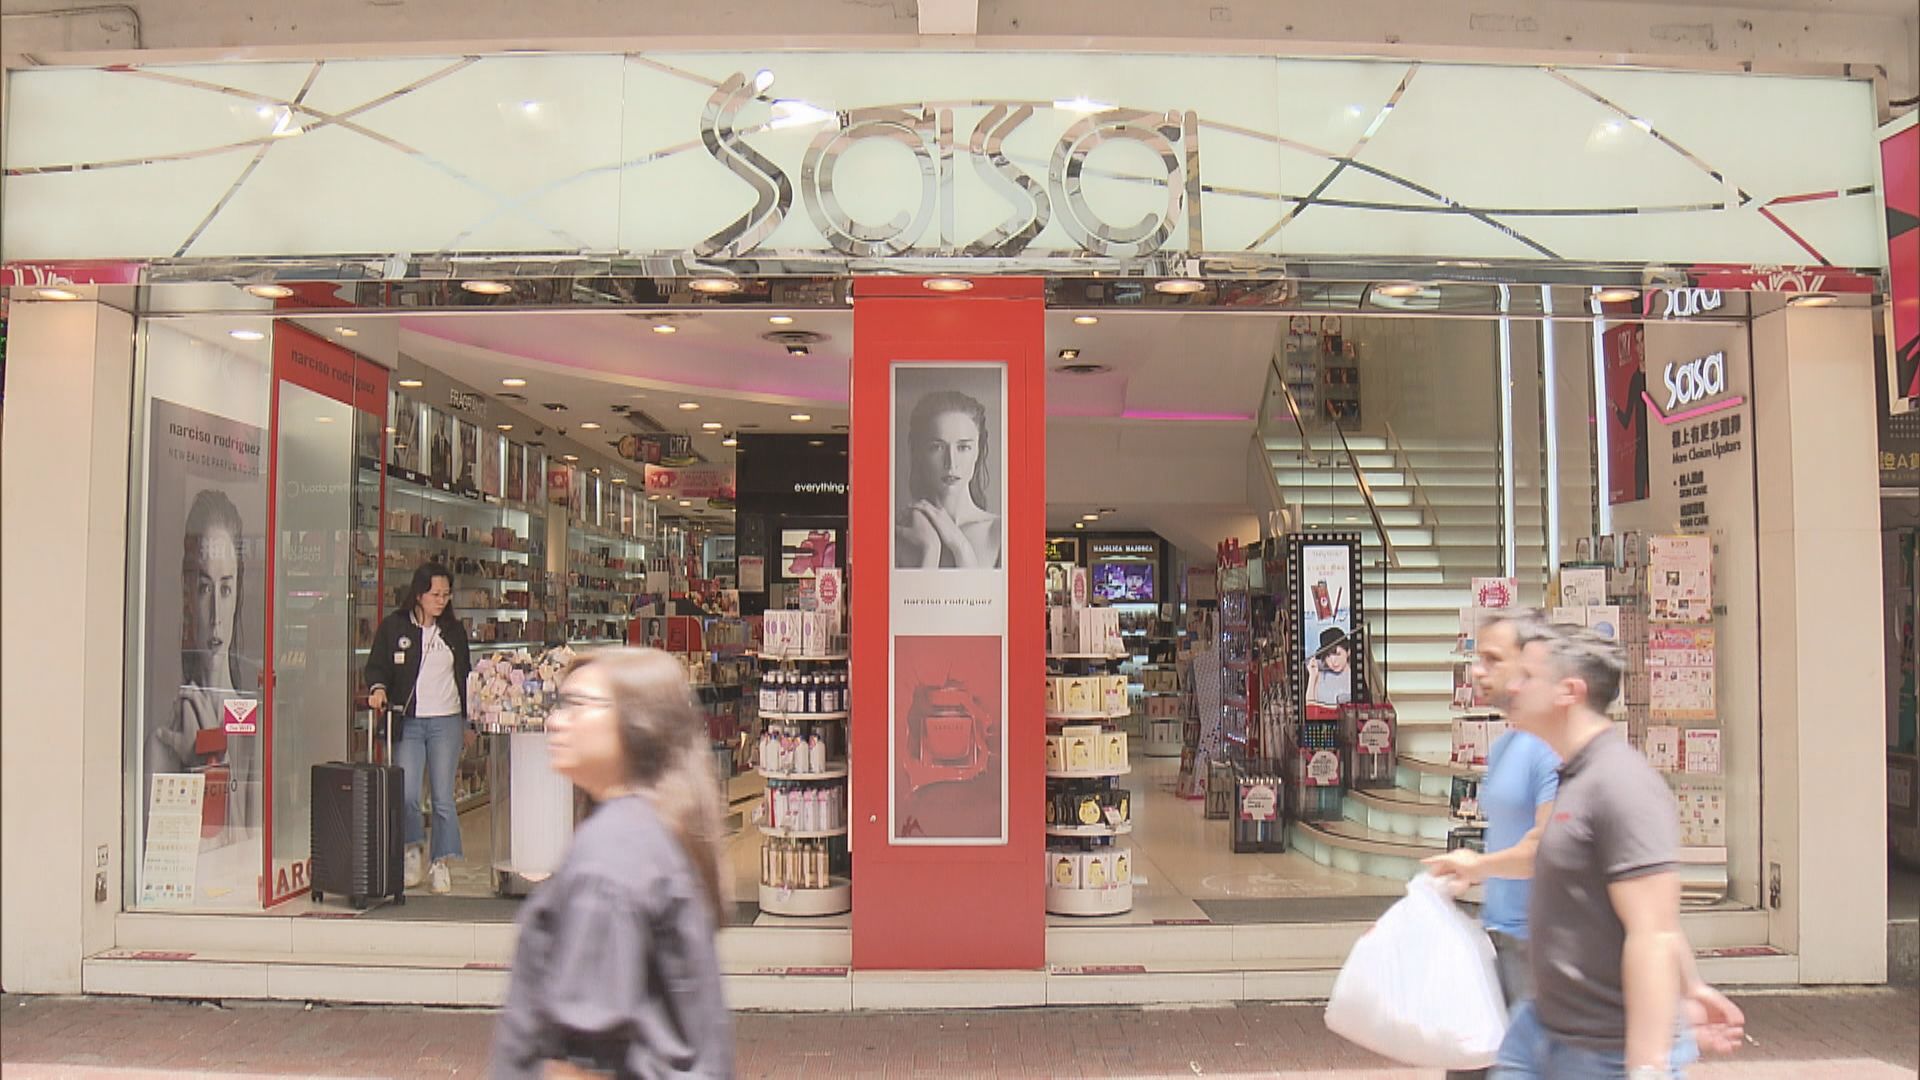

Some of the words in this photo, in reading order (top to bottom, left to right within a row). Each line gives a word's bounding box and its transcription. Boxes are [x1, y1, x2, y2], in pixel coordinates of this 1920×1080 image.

[169, 423, 211, 443] narciso
[214, 435, 261, 456] rodriguez
[794, 481, 845, 495] everything
[1093, 544, 1123, 552] MAJOLICA
